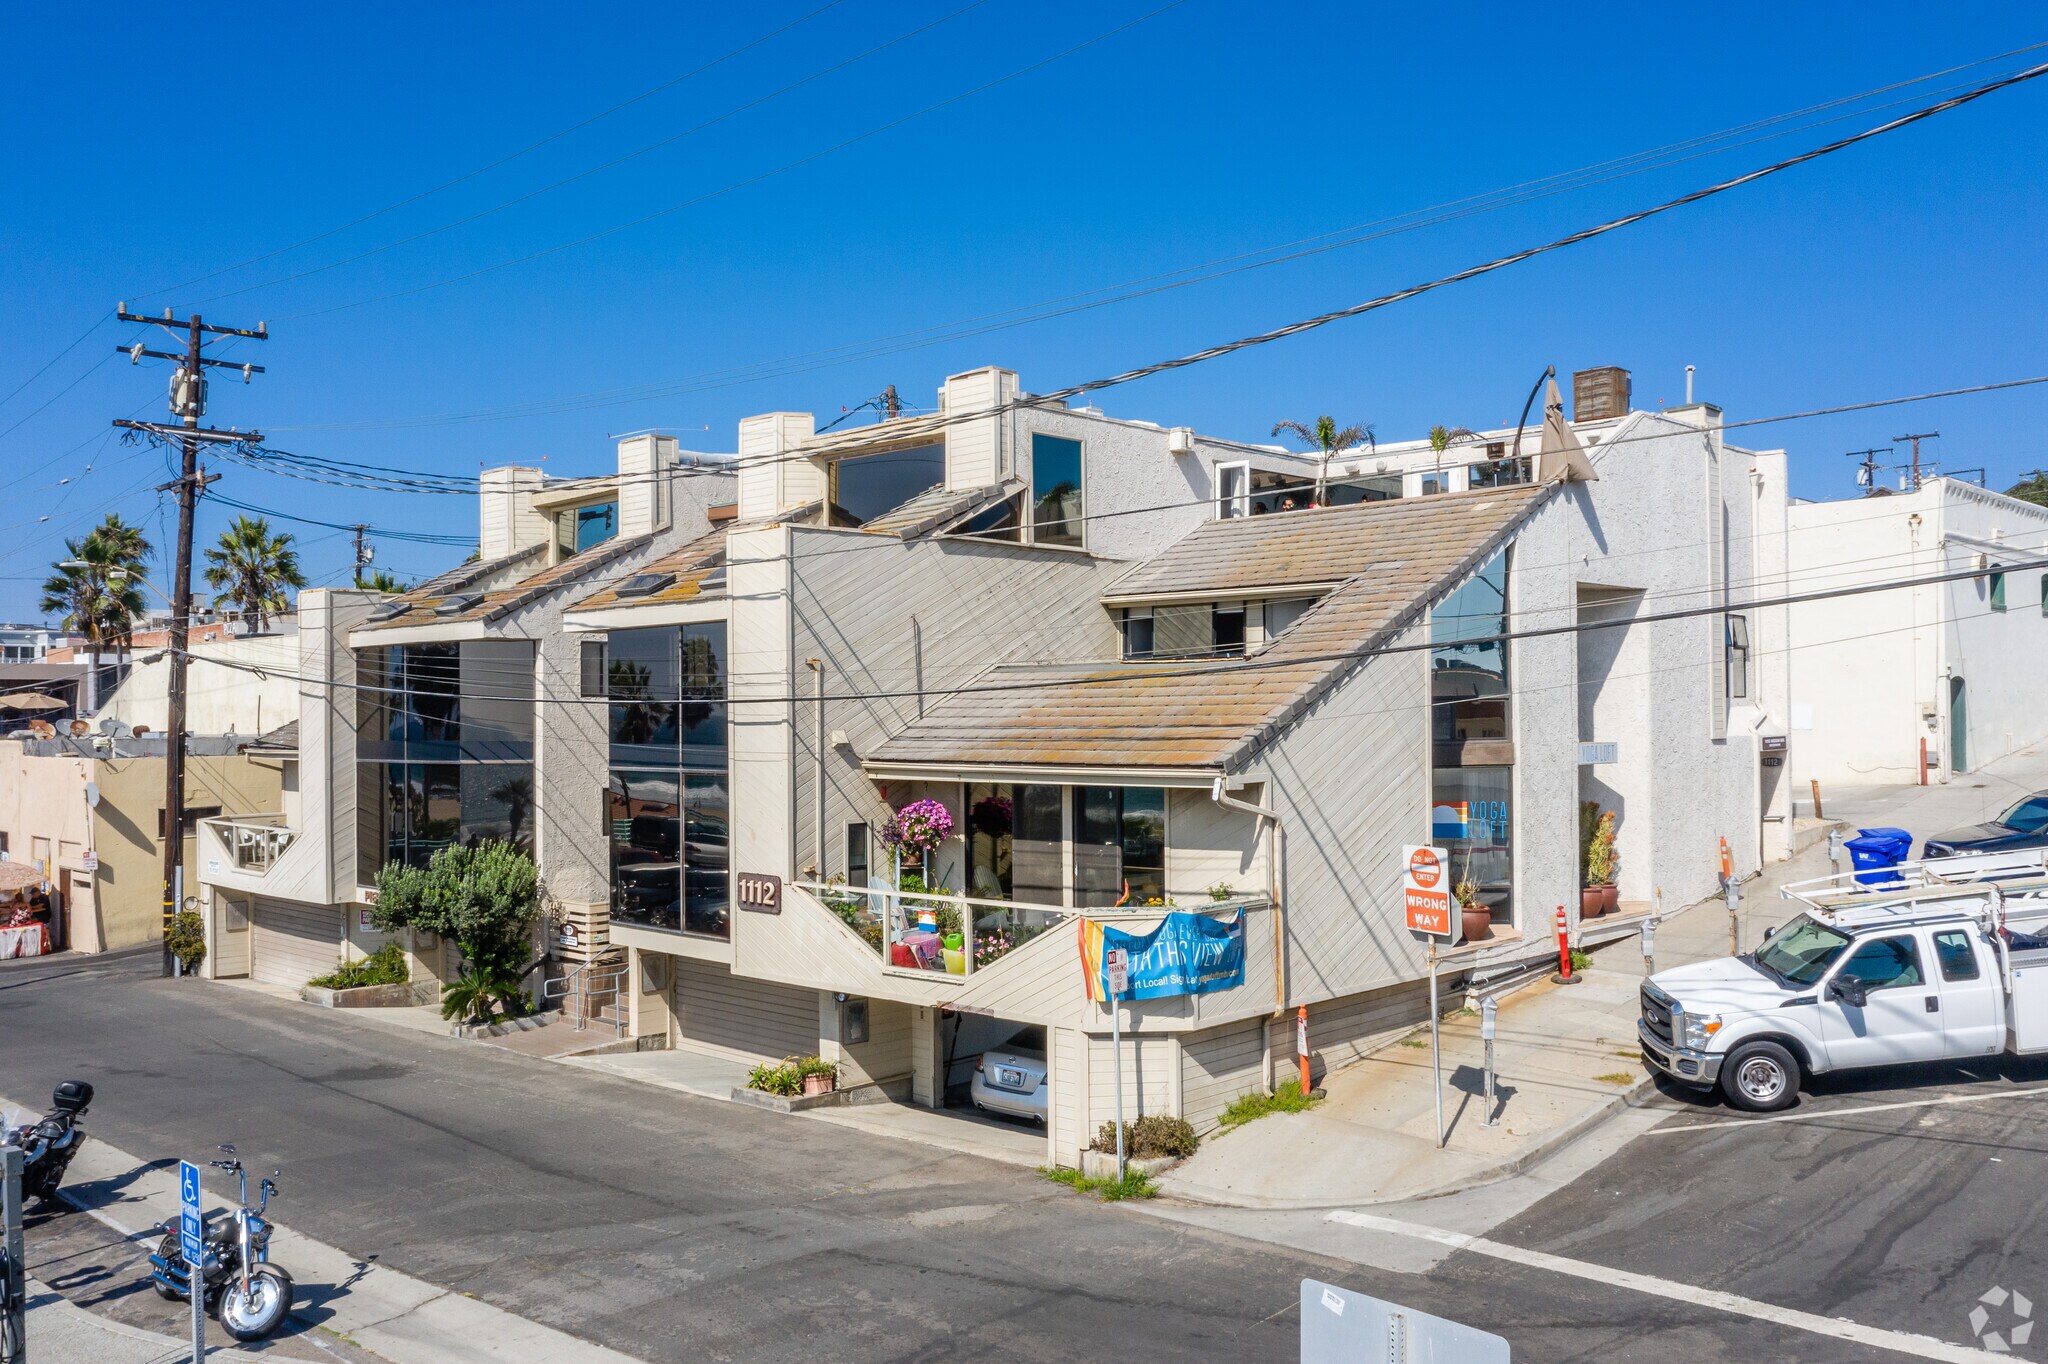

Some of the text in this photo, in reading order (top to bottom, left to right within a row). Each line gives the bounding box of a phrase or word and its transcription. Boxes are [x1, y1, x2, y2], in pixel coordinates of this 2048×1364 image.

[1470, 800, 1507, 820] YOGA
[1469, 820, 1507, 839] LOFT
[1424, 856, 1436, 864] NOT
[1416, 873, 1434, 882] ENTER
[738, 879, 775, 906] 1112
[1407, 895, 1447, 911] WRONG
[1414, 912, 1439, 927] WAY
[1108, 952, 1115, 963] NO
[1191, 942, 1224, 968] VIEW
[1109, 963, 1127, 973] PARKING
[1114, 981, 1122, 990] SIDE
[1143, 974, 1168, 988] Local!
[182, 1200, 199, 1221] PARKING
[185, 1218, 196, 1234] ONLY
